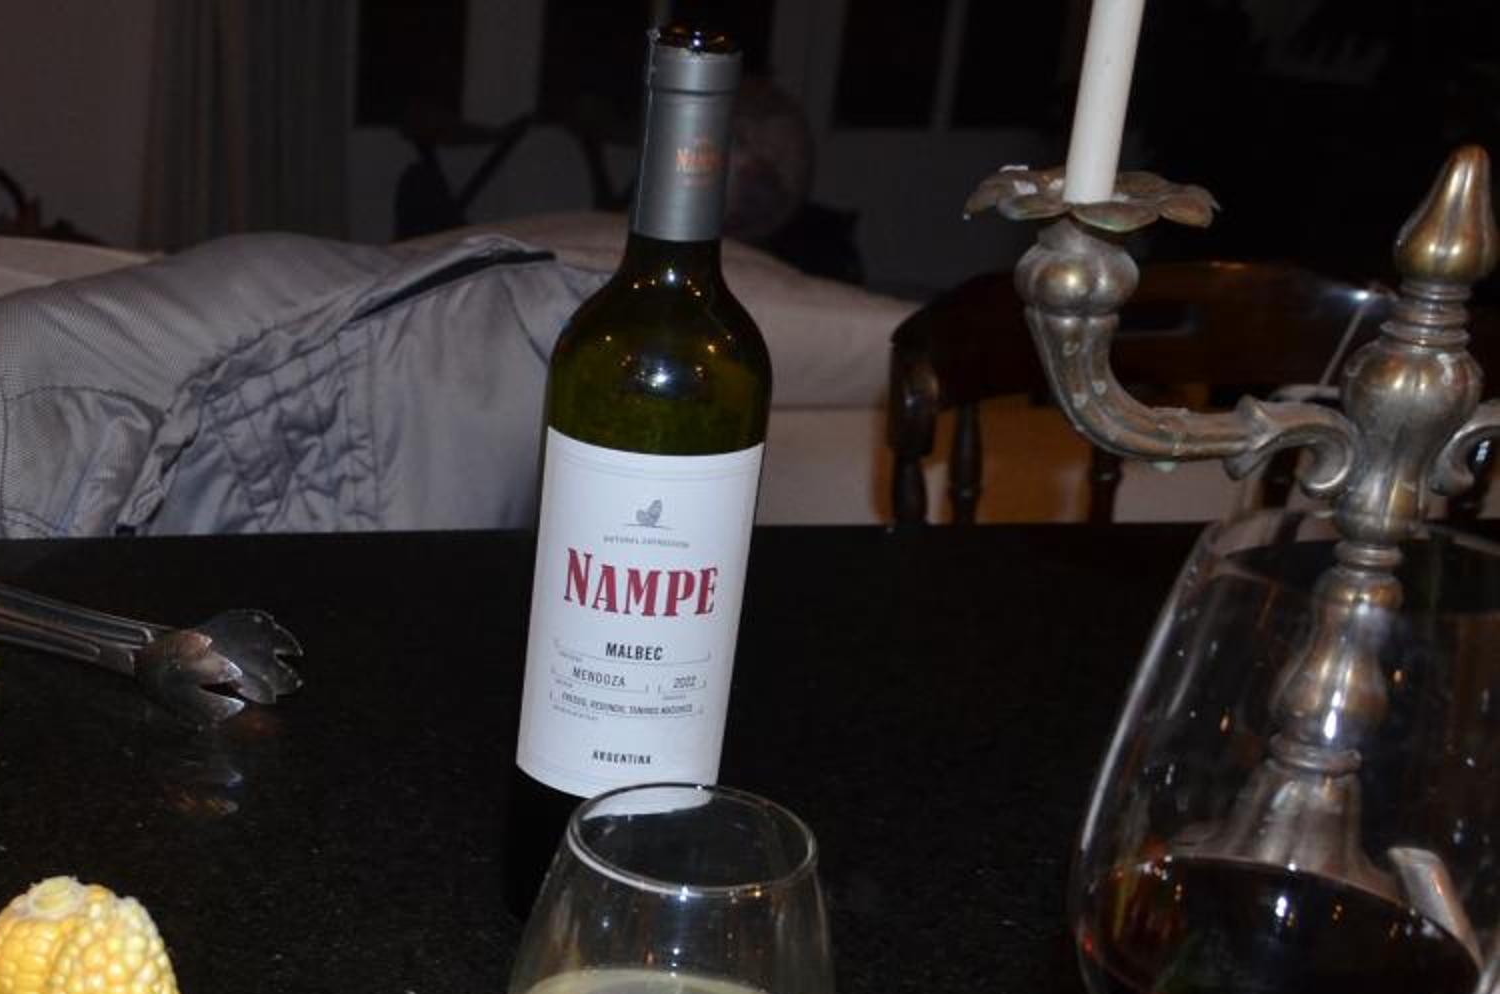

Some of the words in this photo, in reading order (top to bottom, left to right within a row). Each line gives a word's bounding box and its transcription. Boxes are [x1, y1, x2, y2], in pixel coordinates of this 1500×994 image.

[564, 547, 718, 617] NAMPE
[605, 642, 663, 661] MALBEC
[572, 666, 626, 687] MENDOZA
[592, 750, 651, 765] ARGENTINA
